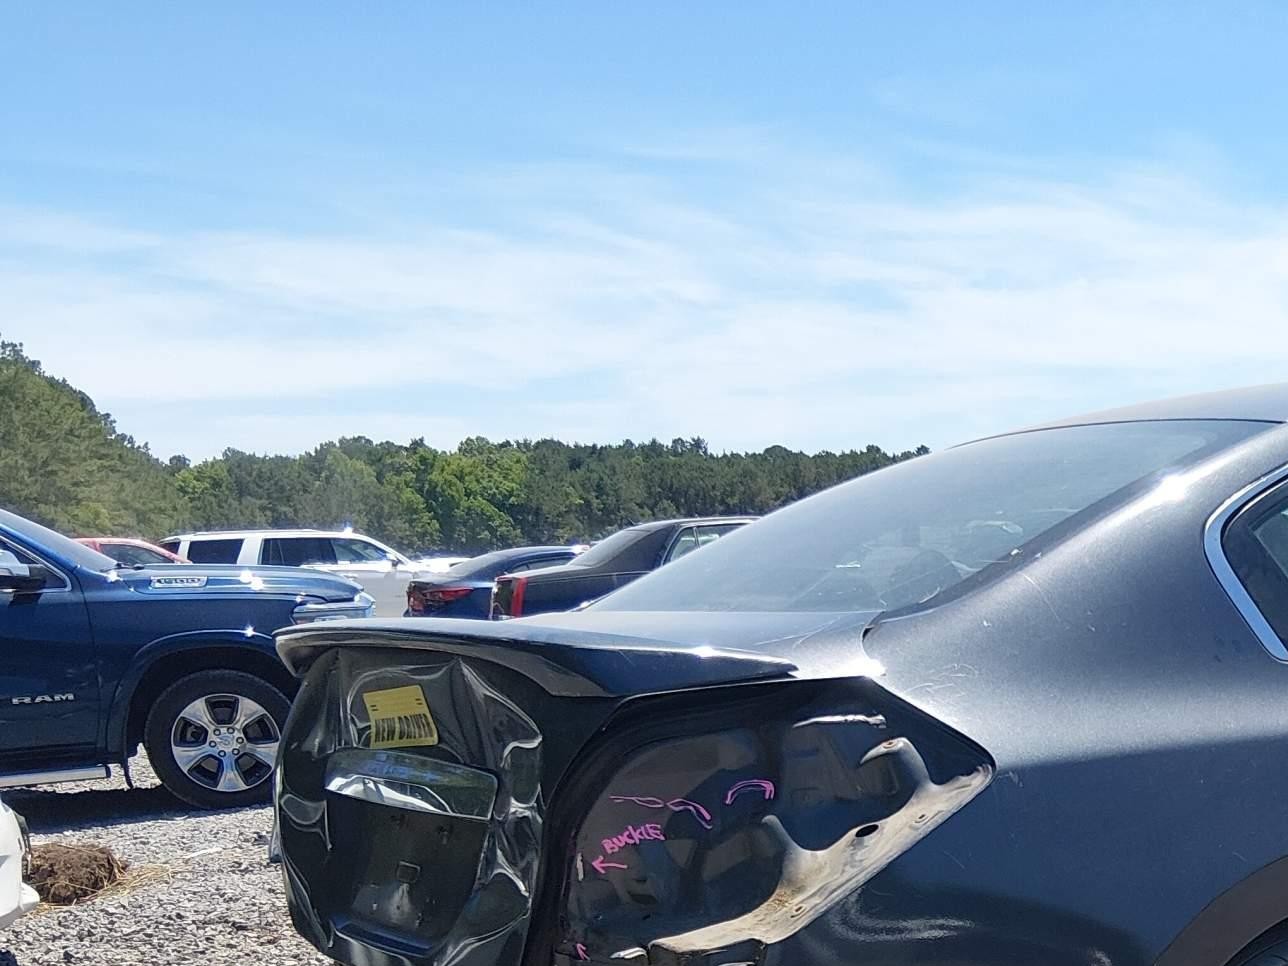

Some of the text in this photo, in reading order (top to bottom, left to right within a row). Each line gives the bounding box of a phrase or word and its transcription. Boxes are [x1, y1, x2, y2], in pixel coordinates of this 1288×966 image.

[12, 693, 75, 704] RAM
[374, 714, 434, 743] NEW DRIVER
[602, 823, 665, 854] BUCKLE
